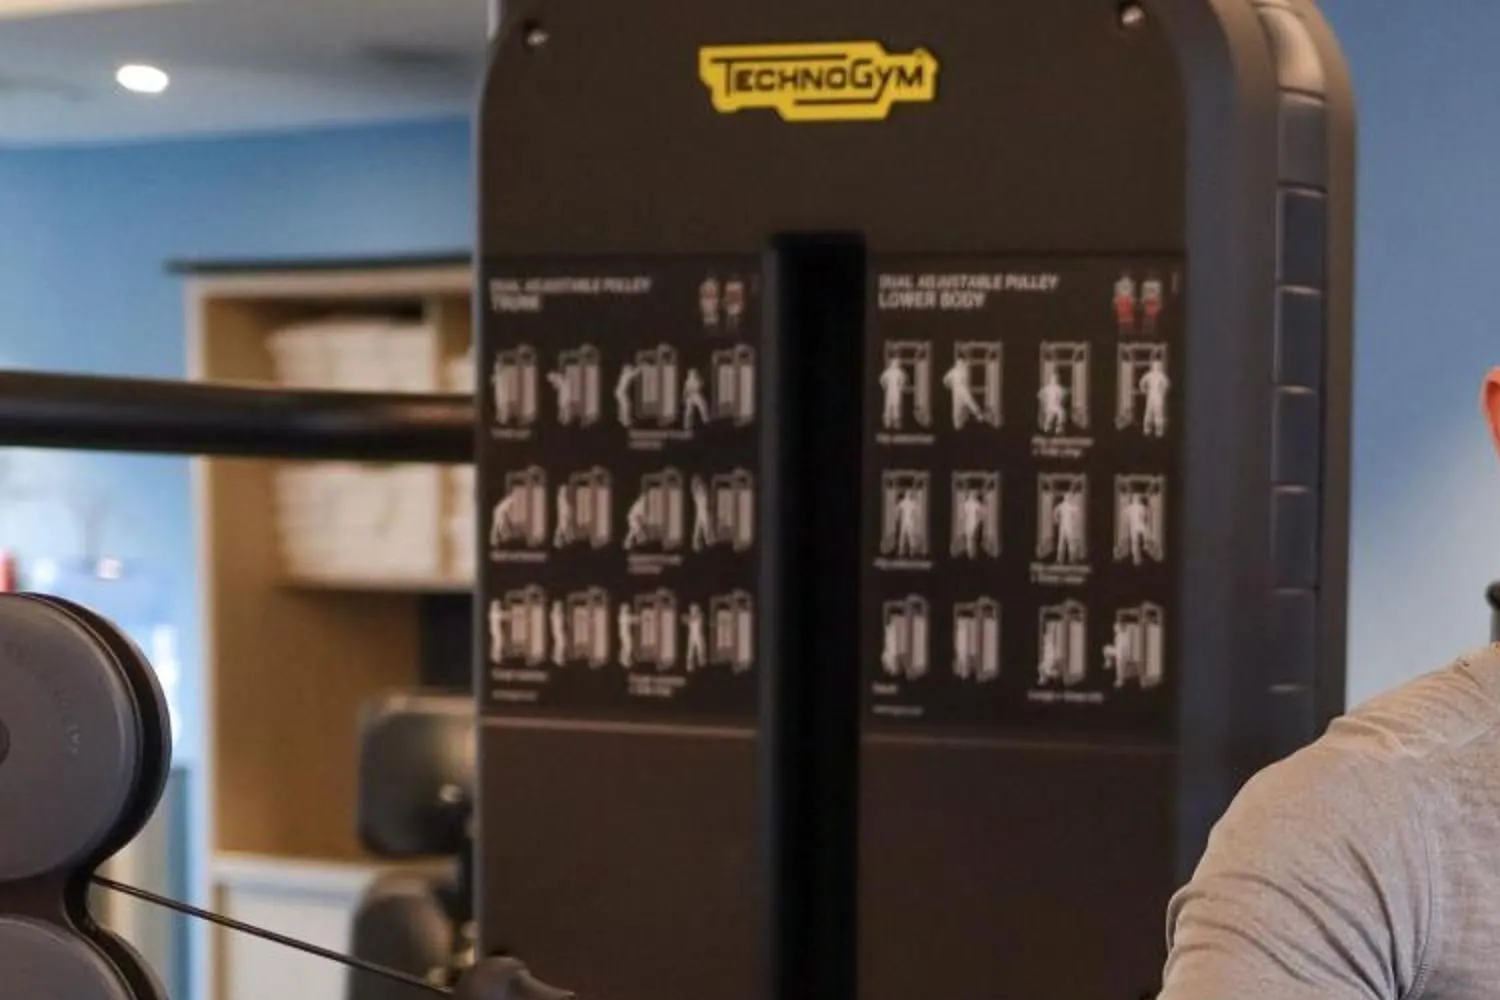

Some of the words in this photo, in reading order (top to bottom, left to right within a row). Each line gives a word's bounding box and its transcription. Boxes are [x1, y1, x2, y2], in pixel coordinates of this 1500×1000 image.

[1005, 273, 1060, 291] PULLEY
[878, 291, 936, 310] LOWER
[939, 291, 986, 310] BODY
